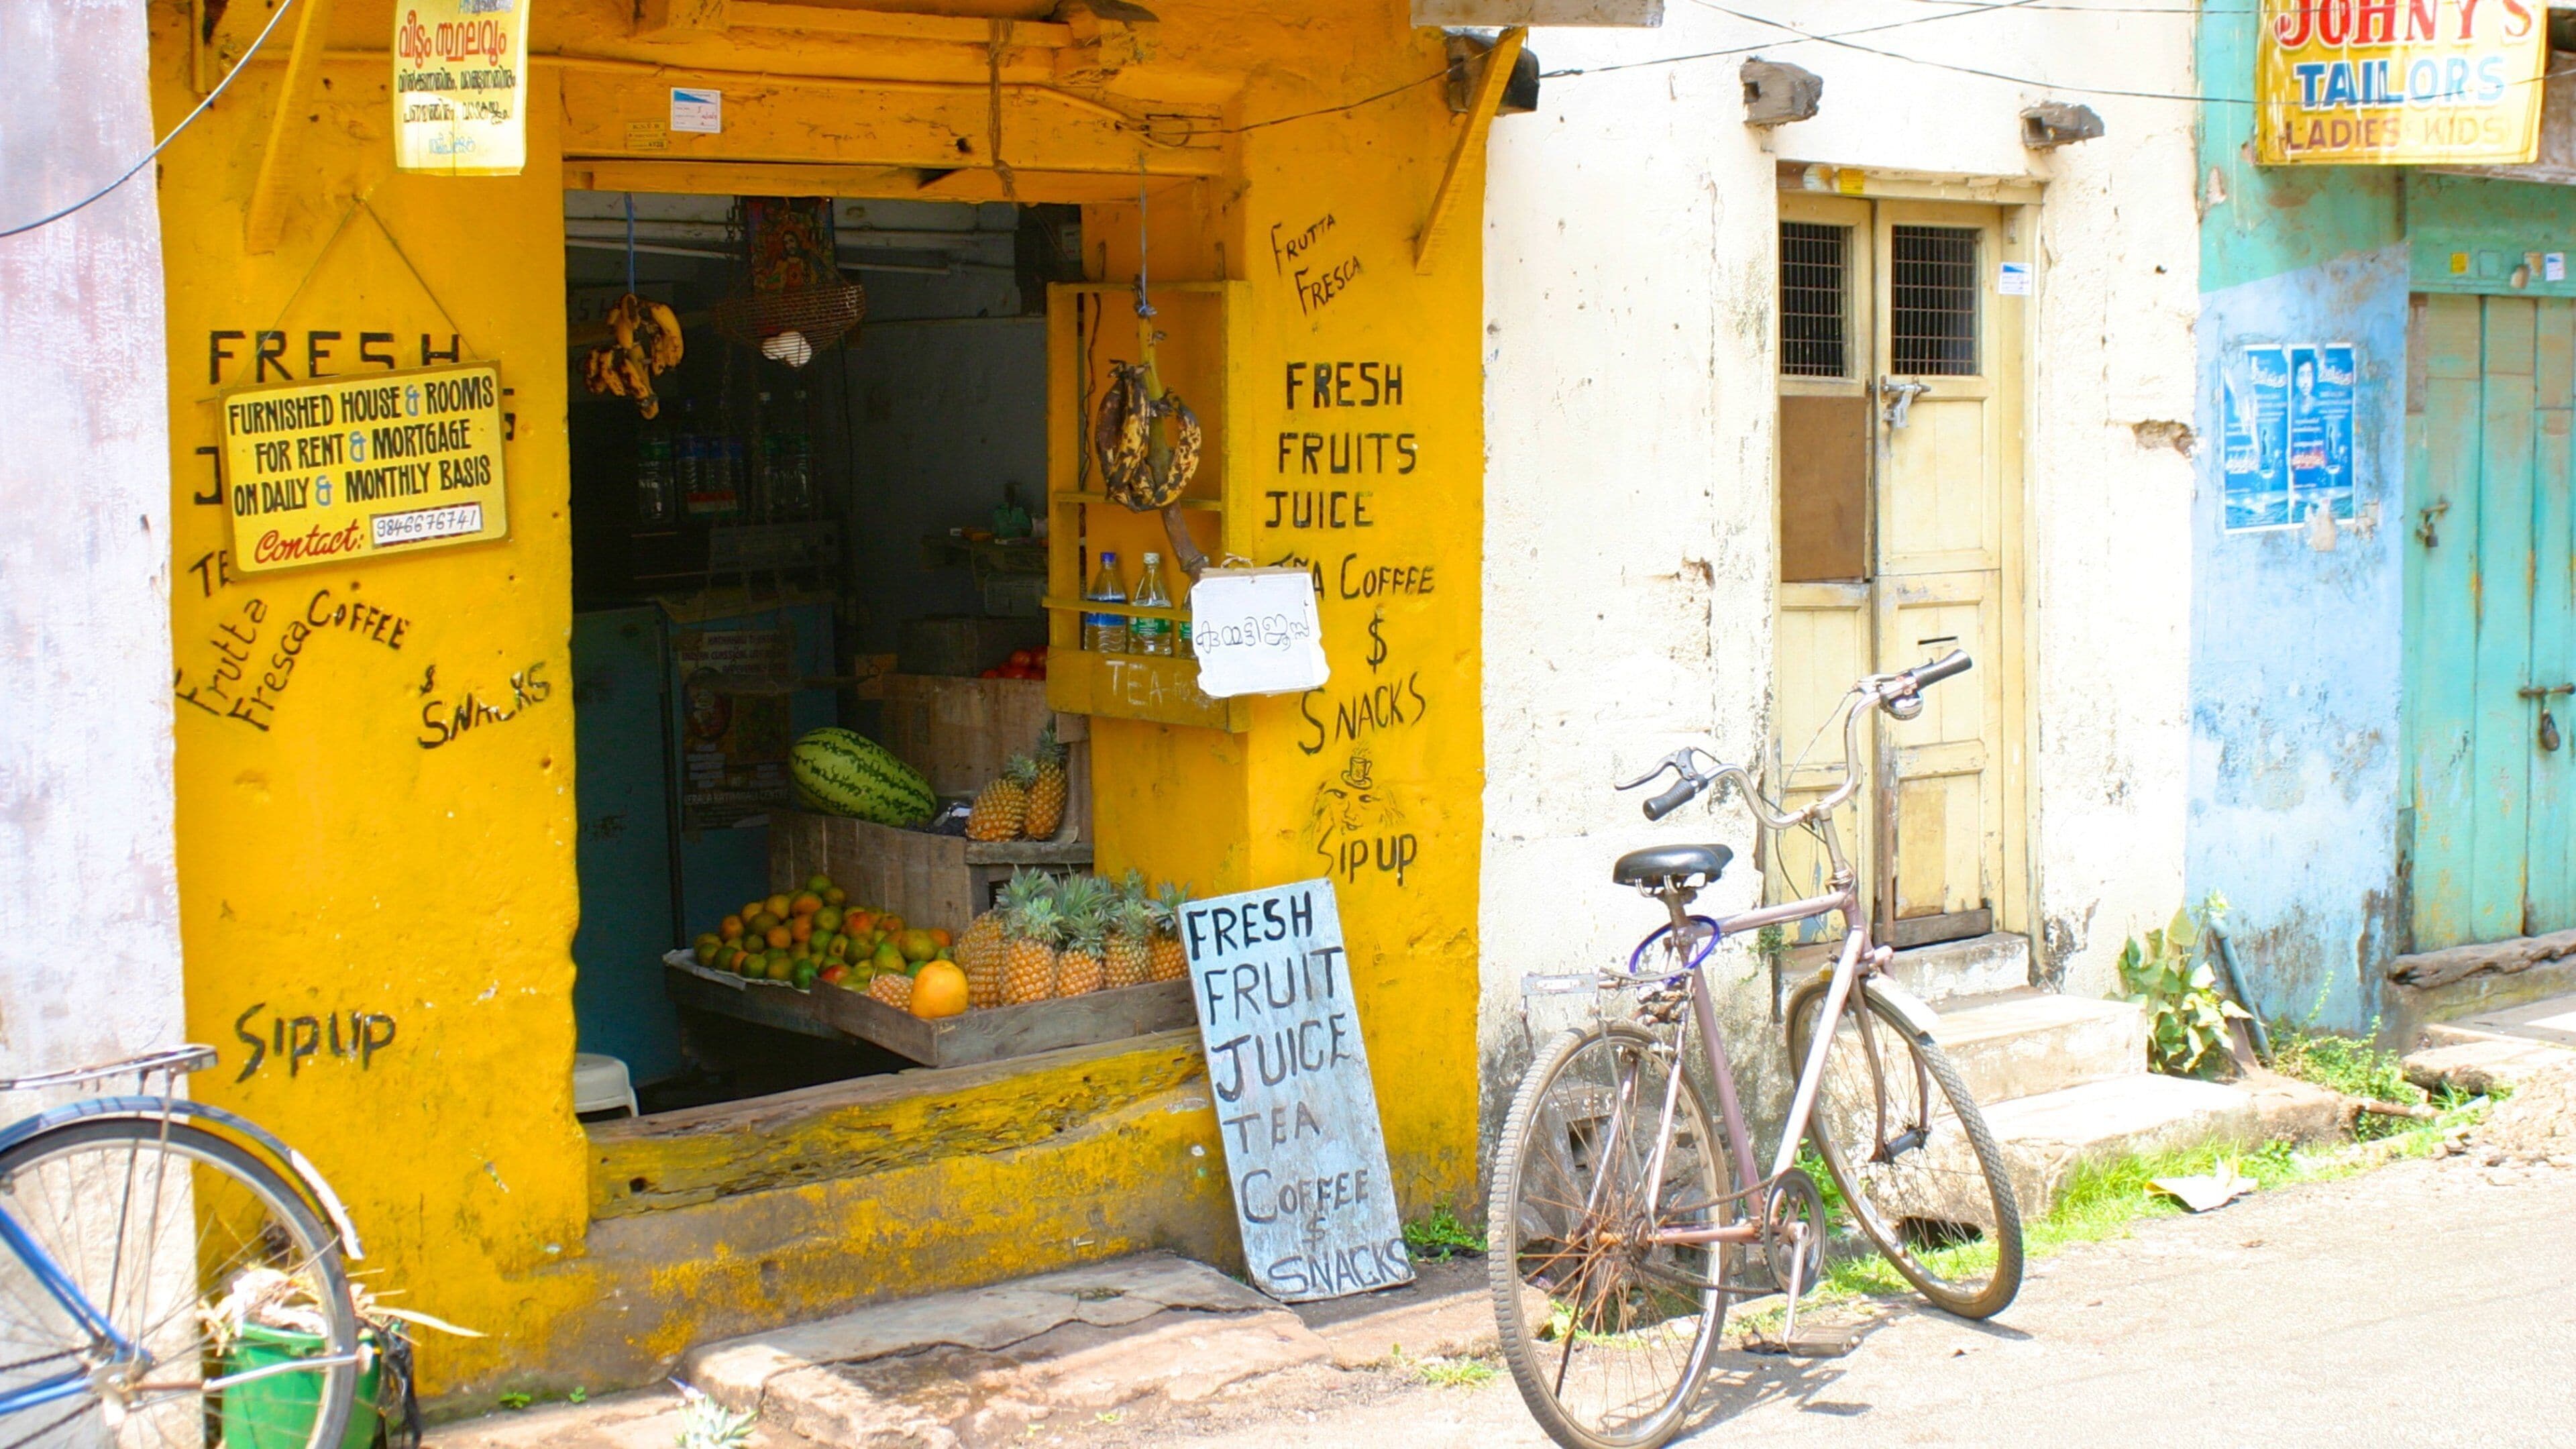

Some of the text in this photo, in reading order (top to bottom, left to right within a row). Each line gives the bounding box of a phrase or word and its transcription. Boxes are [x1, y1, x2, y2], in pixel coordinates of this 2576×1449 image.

[2296, 56, 2506, 107] TAILORS
[2286, 119, 2400, 150] LADIES
[2424, 116, 2509, 146] KIDS
[210, 330, 460, 385] FRESH
[228, 375, 494, 436] FURNISHED HOUSE & ROOMS
[1286, 361, 1403, 411] FRESH
[255, 419, 472, 475] FOR RENT & MORTGAGE
[1278, 432, 1417, 475] FRUITS
[233, 454, 491, 517] ON DAILY & MONTHLY BASIS
[1265, 491, 1374, 529] JUICE
[254, 510, 476, 564] Contact: 9846676741
[307, 589, 411, 650] COFFEE
[1366, 609, 1388, 674] $
[1297, 671, 1427, 756] SNACKS
[1186, 890, 1313, 961] FRESH
[1204, 946, 1344, 1026] FRUIT
[1211, 1013, 1351, 1103] JUICE
[1222, 1101, 1321, 1155] TEA
[1240, 1168, 1369, 1224] COFFEE
[1267, 1237, 1414, 1295] SNACKS
